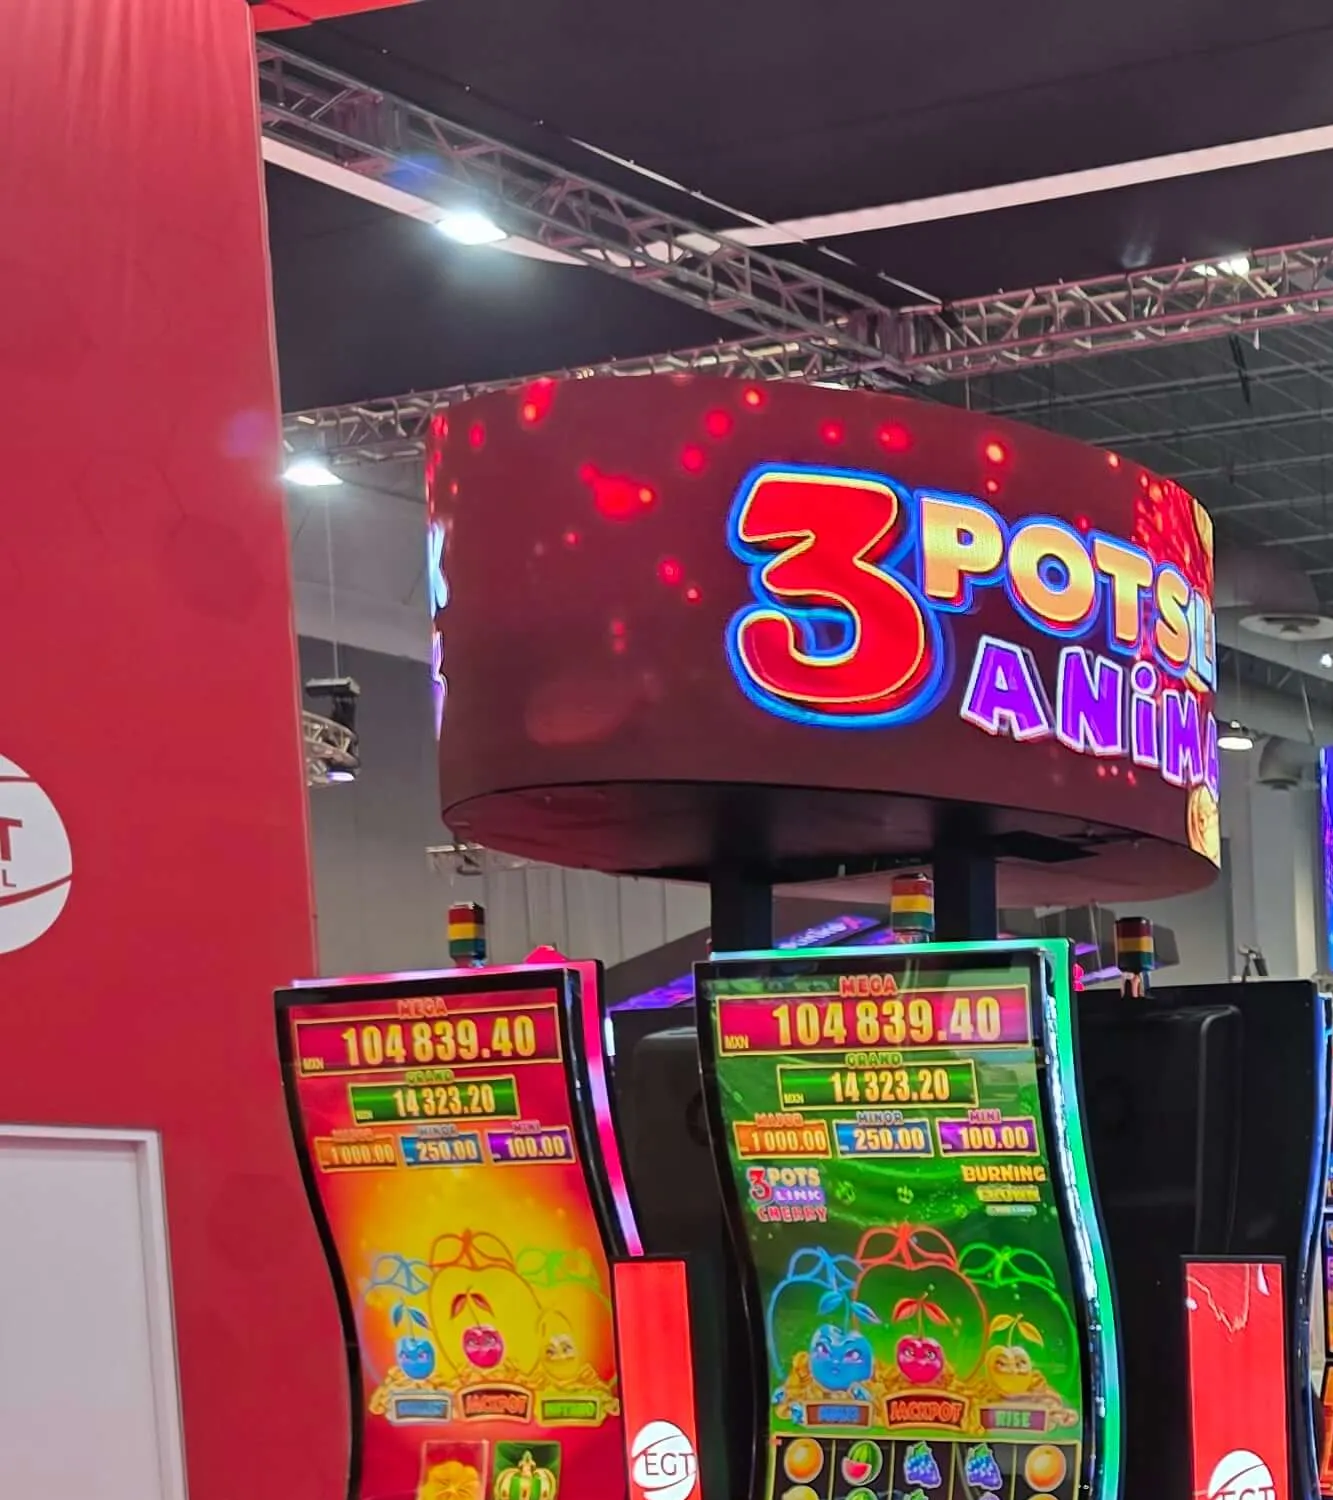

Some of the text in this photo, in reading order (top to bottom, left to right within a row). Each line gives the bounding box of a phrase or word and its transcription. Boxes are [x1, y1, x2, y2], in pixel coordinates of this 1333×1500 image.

[733, 467, 938, 717] 3
[917, 493, 1190, 670] POTS
[839, 974, 898, 999] MEGA
[724, 1035, 749, 1050] MXN
[845, 1052, 903, 1067] GRAND
[856, 1111, 904, 1126] MINOR
[968, 1109, 1002, 1124] MINI
[504, 1136, 565, 1159] 100.00
[853, 1128, 925, 1151] 250.00
[960, 1126, 1029, 1149] 100.00
[416, 1140, 478, 1161] 250.00
[962, 1164, 1047, 1182] BURNING
[747, 1167, 821, 1203] 3 POTS
[756, 1207, 828, 1222] CHERRY
[889, 1400, 962, 1422] JACKPOT
[643, 1452, 696, 1478] EGT
